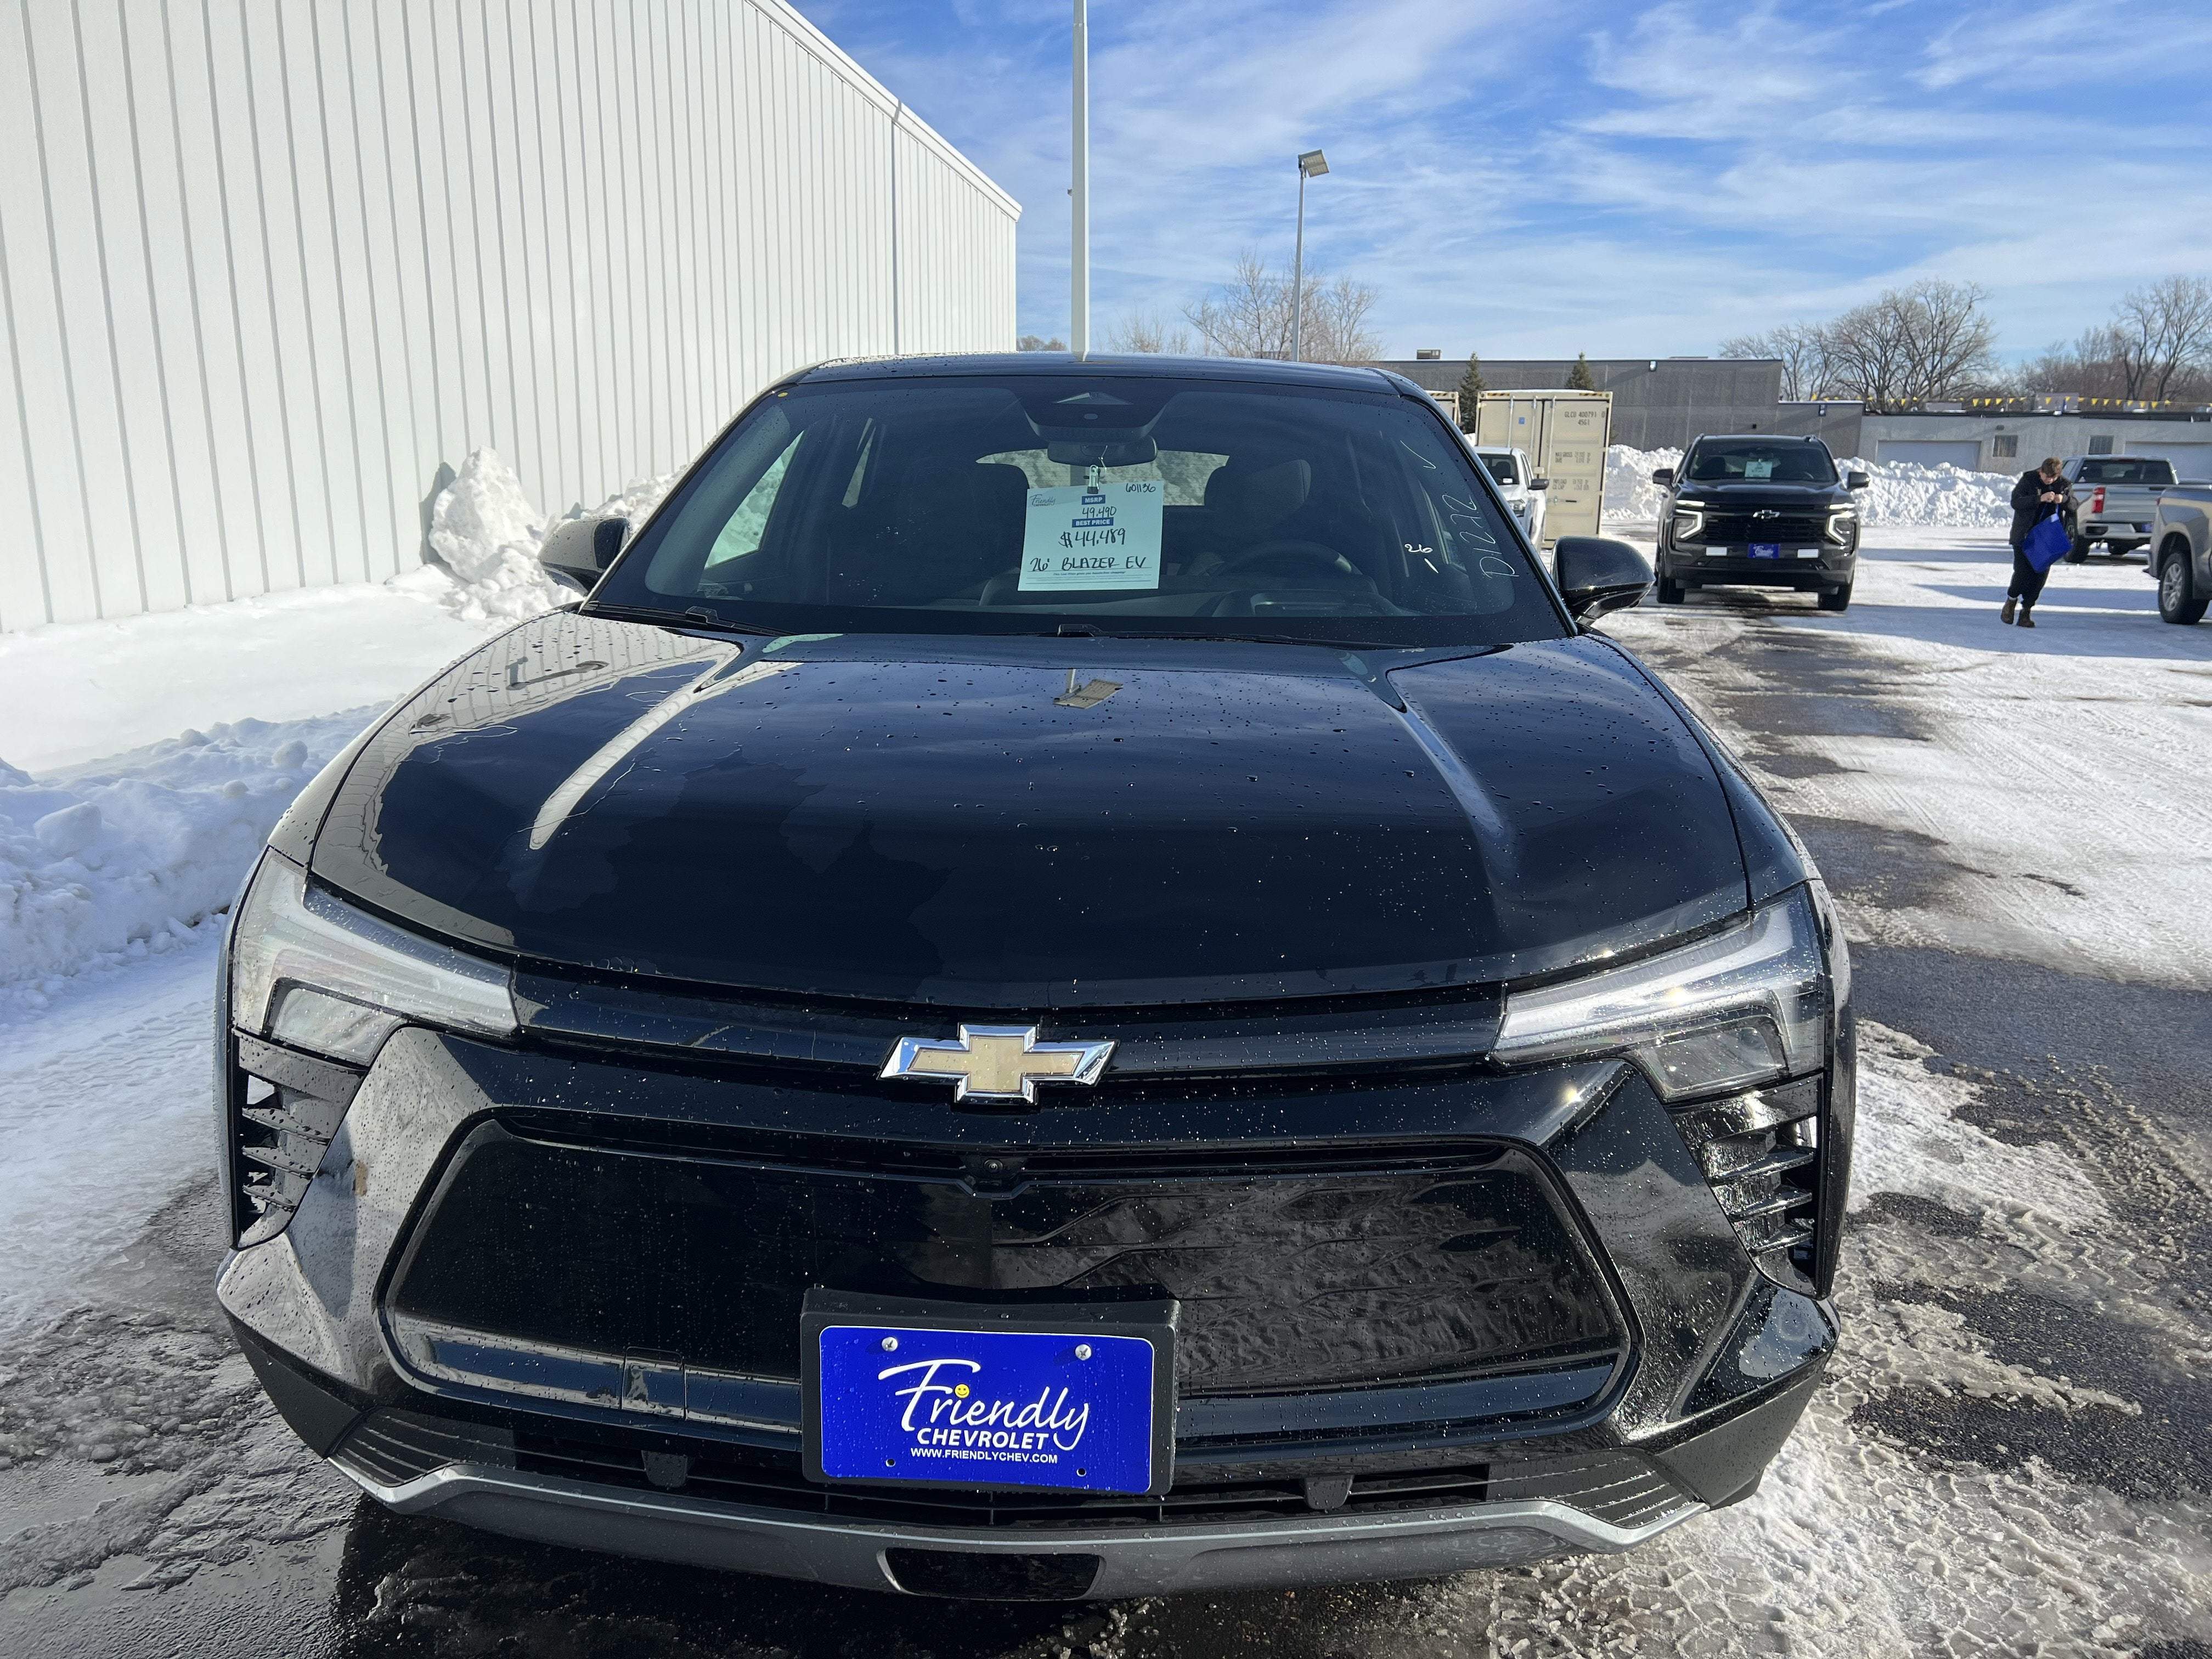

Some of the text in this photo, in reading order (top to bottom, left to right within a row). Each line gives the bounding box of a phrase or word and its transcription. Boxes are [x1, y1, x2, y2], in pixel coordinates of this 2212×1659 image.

[1126, 483, 1156, 493] 601136
[1029, 494, 1056, 506] Friendly
[1404, 543, 1433, 554] 26
[1061, 556, 1120, 571] BLAZER
[1126, 555, 1147, 569] EV
[878, 1358, 1090, 1451] Friendly
[917, 1427, 1048, 1450] CHEVROLET
[910, 1447, 1058, 1464] WWW.FRIENDLYCHEV.COM
